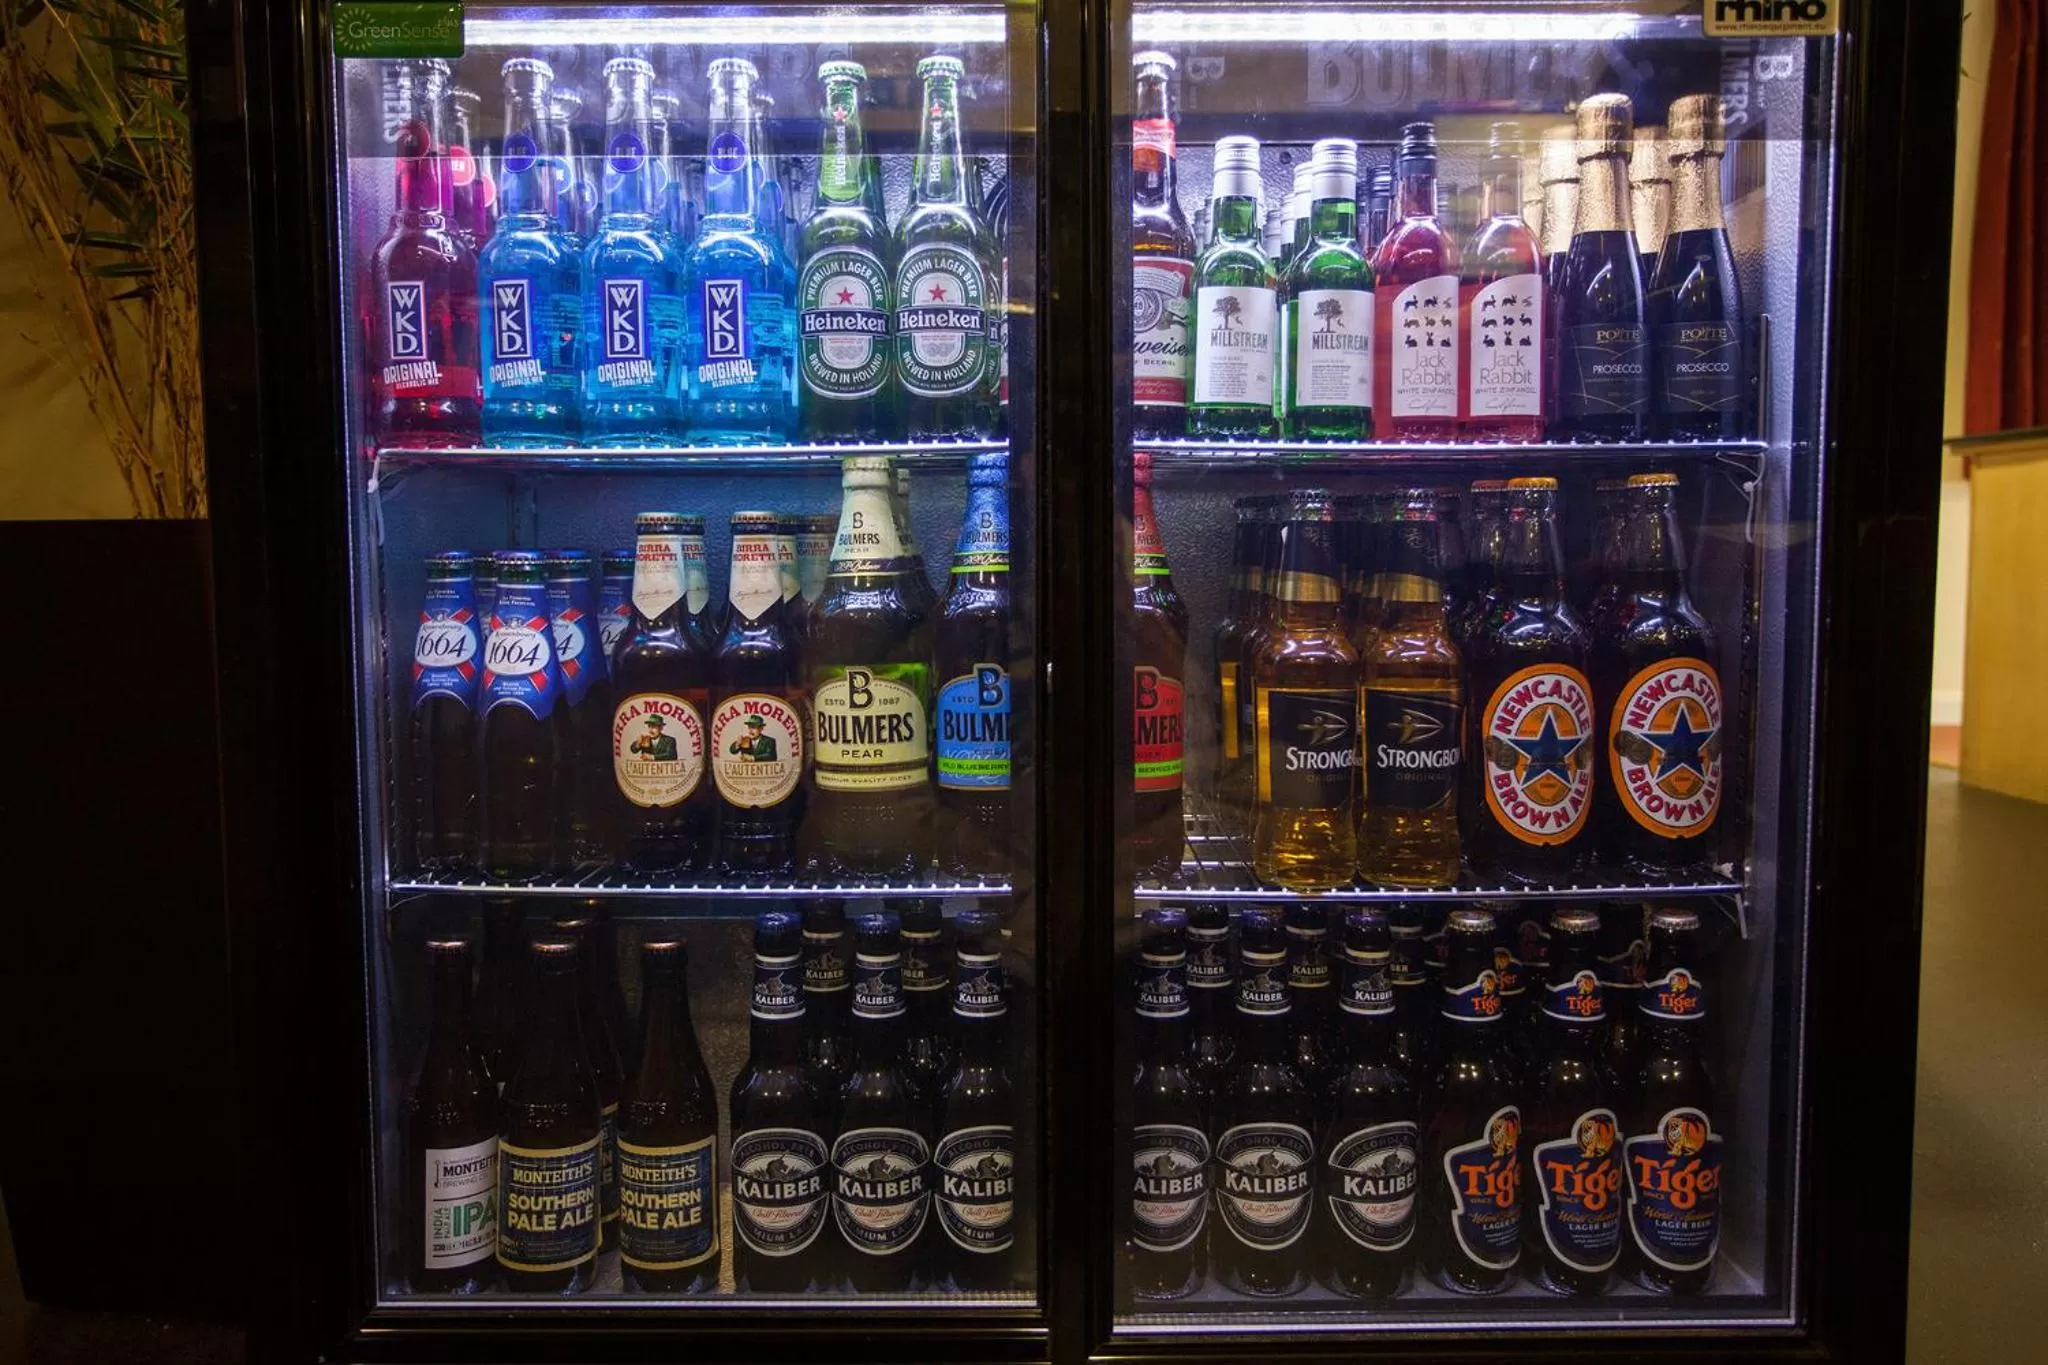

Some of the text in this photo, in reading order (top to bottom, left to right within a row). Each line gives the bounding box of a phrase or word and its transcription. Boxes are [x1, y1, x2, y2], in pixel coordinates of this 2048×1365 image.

[1716, 0, 1826, 21] rhino
[349, 21, 450, 38] GreenSense
[807, 261, 884, 301] PREMIUM LAGER BEER
[901, 258, 977, 298] PREMIUM LAGER BEER
[805, 313, 886, 331] Heineken
[899, 310, 980, 328] Heineken
[1211, 332, 1268, 348] MILLSTREAM
[490, 360, 546, 383] ORIGINAL
[698, 360, 757, 383] ORIGINAL
[808, 353, 837, 382] BREWED
[839, 372, 850, 383] IN
[852, 354, 883, 383] HOLLAND
[903, 350, 976, 381] BREWED IN HOLLAND
[1415, 350, 1447, 370] Jack
[1491, 350, 1525, 370] Jack
[1592, 364, 1642, 374] PROSECCO
[1676, 362, 1730, 372] PROSECCO
[384, 361, 442, 384] ORIGINAL
[598, 360, 656, 384] ORIGINAL
[1402, 368, 1451, 386] Rabbit
[1480, 368, 1532, 385] Rabbit
[852, 511, 864, 529] B
[981, 512, 993, 528] B
[839, 533, 880, 545] BULMERS
[417, 631, 468, 657] 1664
[489, 639, 541, 666] 1664
[848, 671, 873, 709] B
[978, 667, 1003, 706] B
[1495, 679, 1590, 735] NEWCASTLE
[1627, 673, 1721, 730] NEWCASTLE
[614, 700, 702, 758] BIRRA MORETTI
[712, 701, 800, 758] BIRRA MORETTI
[818, 711, 914, 745] BULMERS
[1134, 716, 1184, 746] MERS
[842, 749, 884, 758] PEAR
[626, 761, 686, 776] L'AUTENTICA
[725, 761, 785, 776] L'AUTENTICA
[1494, 771, 1590, 829] BROWN ALE
[1627, 764, 1721, 822] BROWN ALE
[805, 968, 844, 980] KALIBER
[755, 993, 796, 1005] KALIBER
[855, 993, 895, 1005] KALIBER
[959, 993, 999, 1005] KALIBER
[1140, 993, 1181, 1005] KALIBER
[1241, 989, 1283, 1002] KALIBER
[1658, 993, 1697, 1014] Tiger
[512, 1162, 594, 1184] MONTEITH'S
[620, 1163, 697, 1182] MONTEITH'S
[1134, 1172, 1203, 1195] ALIBER
[1225, 1169, 1308, 1194] KALIBER
[1634, 1155, 1720, 1210] Tiger
[507, 1184, 595, 1211] SOUTHERN
[620, 1187, 702, 1210] SOUTHERN
[737, 1175, 821, 1200] KALIBER
[838, 1175, 922, 1199] KALIBER
[452, 1195, 498, 1237] IPA
[507, 1203, 595, 1232] PALE ALE
[620, 1203, 702, 1230] PALE ALE
[1655, 1220, 1689, 1229] LAGER
